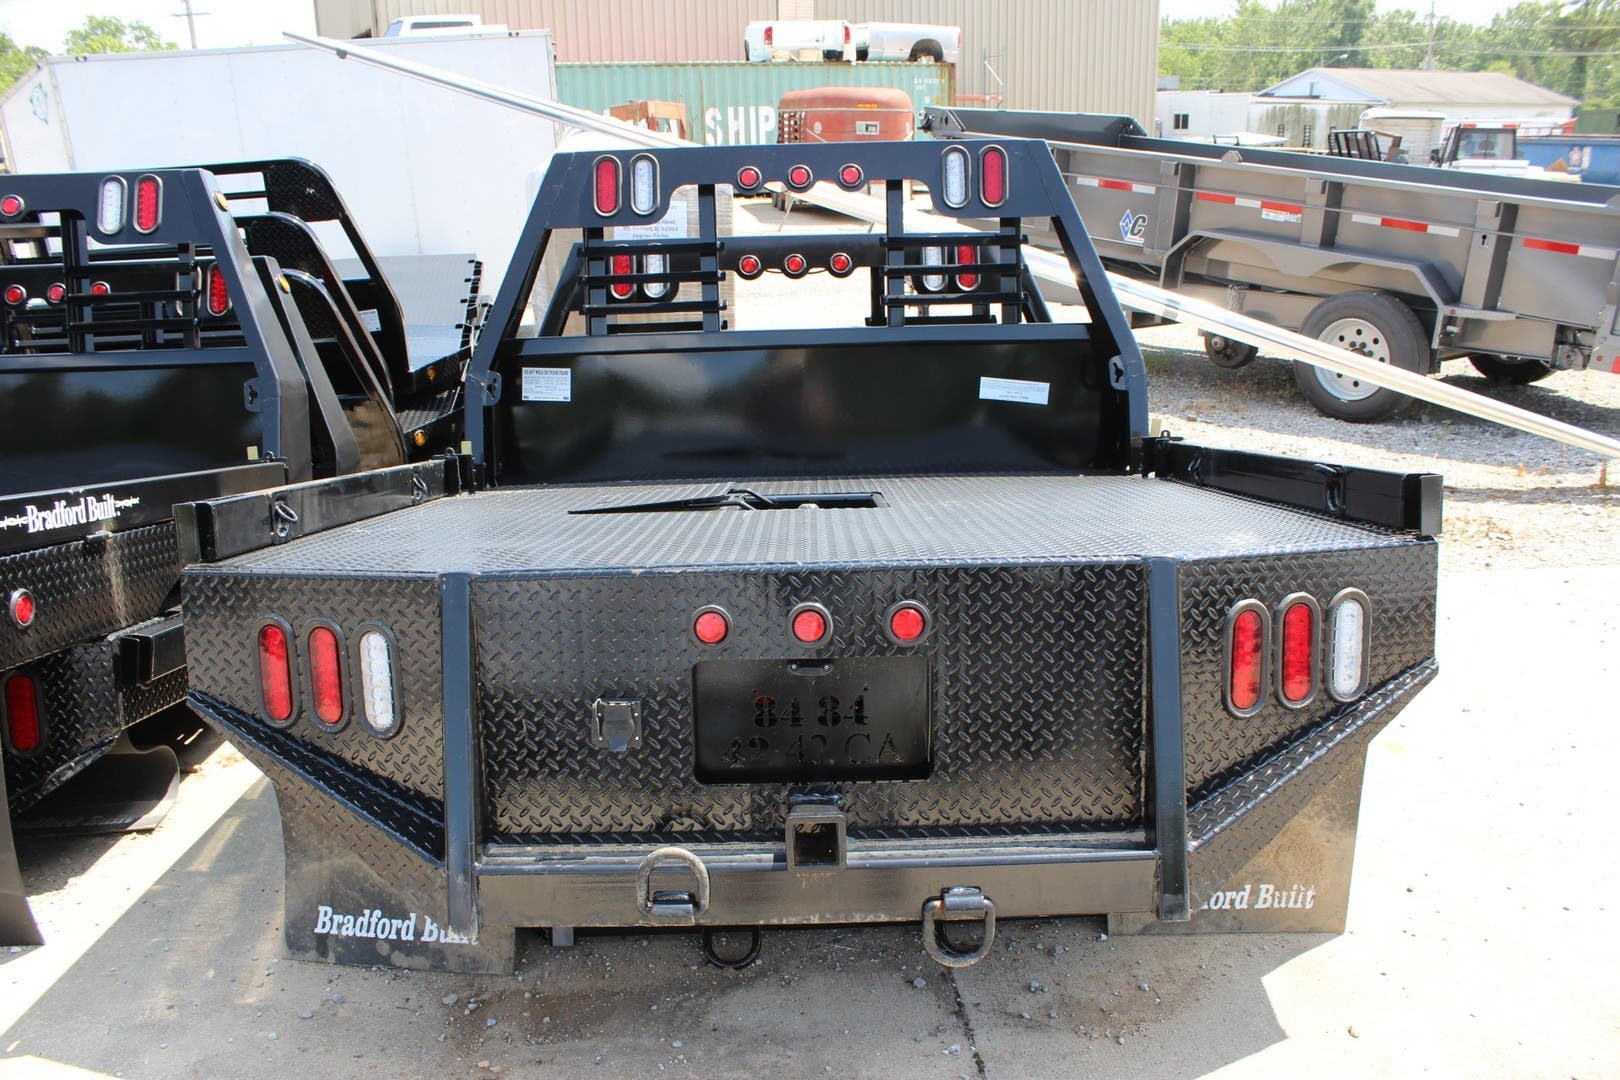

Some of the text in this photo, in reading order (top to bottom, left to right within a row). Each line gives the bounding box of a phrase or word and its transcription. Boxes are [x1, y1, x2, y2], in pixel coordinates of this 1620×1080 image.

[25, 498, 87, 533] Bradford
[1201, 885, 1251, 910] ord
[314, 905, 417, 941] Bradford
